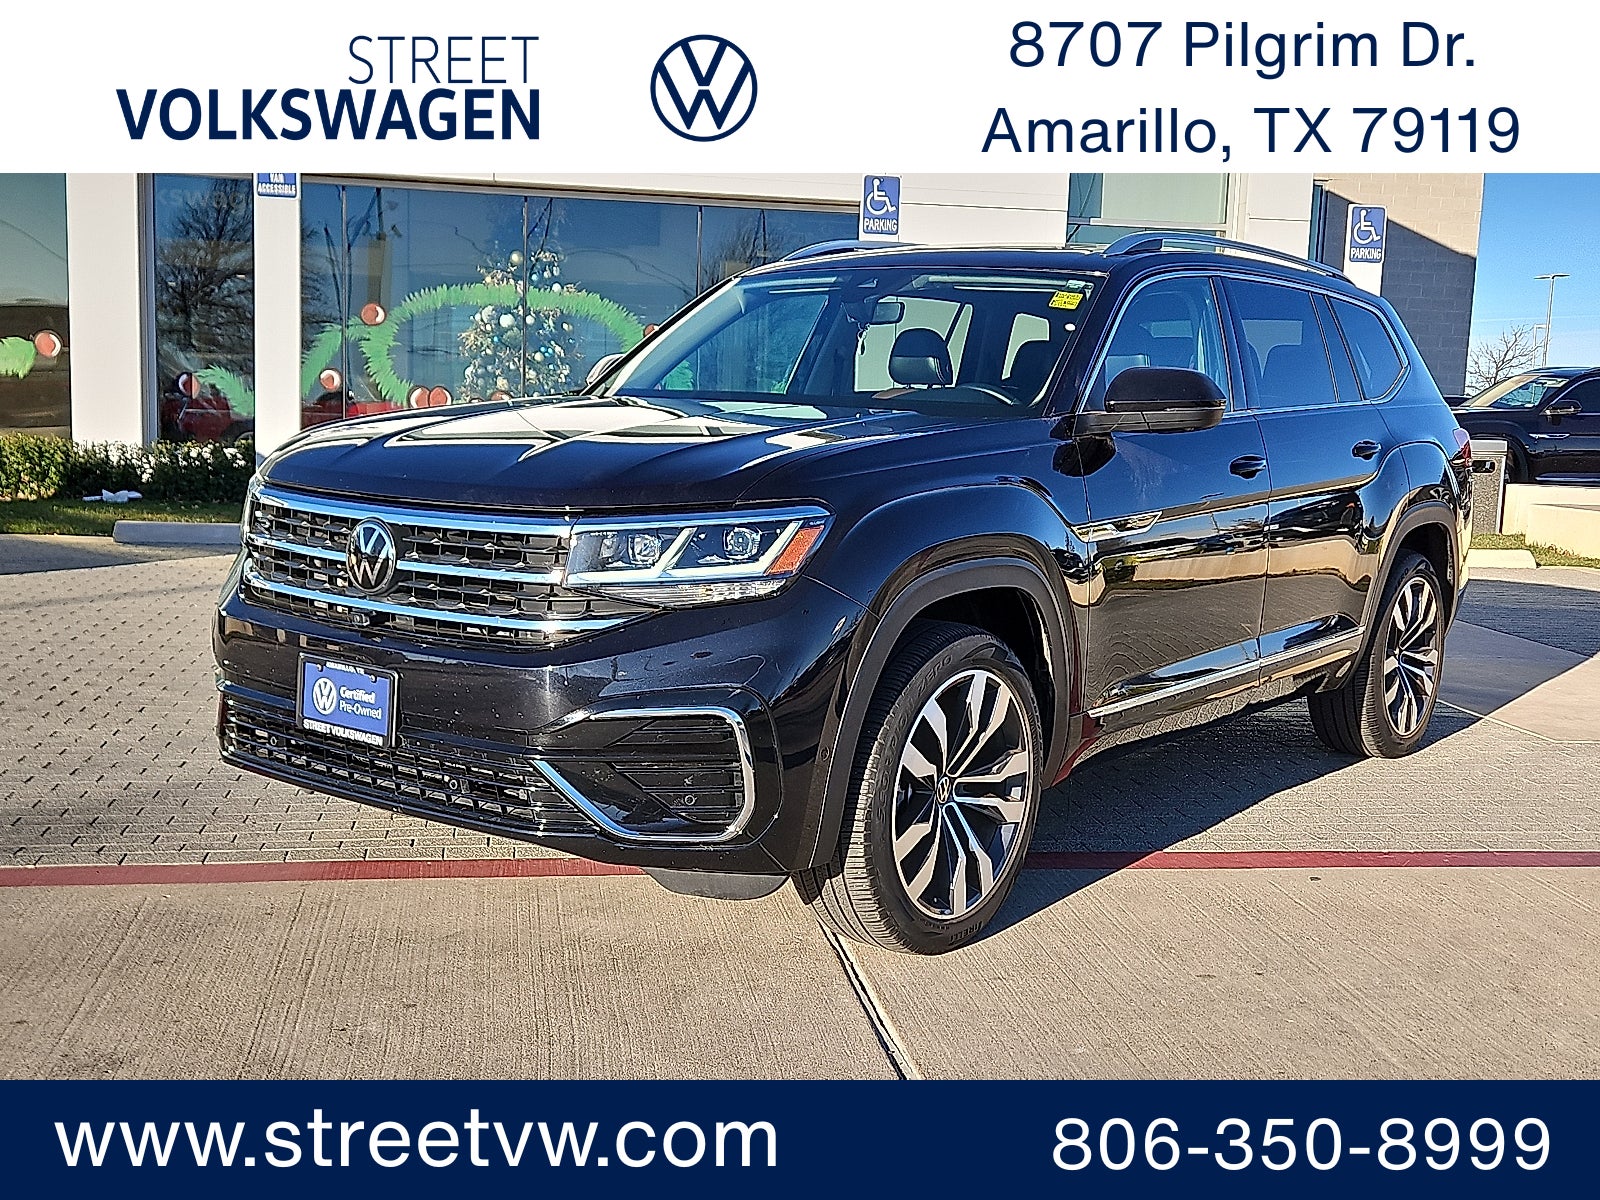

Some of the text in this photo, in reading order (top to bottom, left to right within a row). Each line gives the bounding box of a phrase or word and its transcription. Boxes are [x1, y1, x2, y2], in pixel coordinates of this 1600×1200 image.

[258, 182, 296, 195] ACCESSIBLE
[863, 217, 897, 232] PARKING
[1350, 247, 1382, 260] PARKING
[339, 685, 376, 704] Certified
[339, 700, 382, 720] Pre-Owned
[303, 718, 383, 747] STREET VOLKSWAGEN
